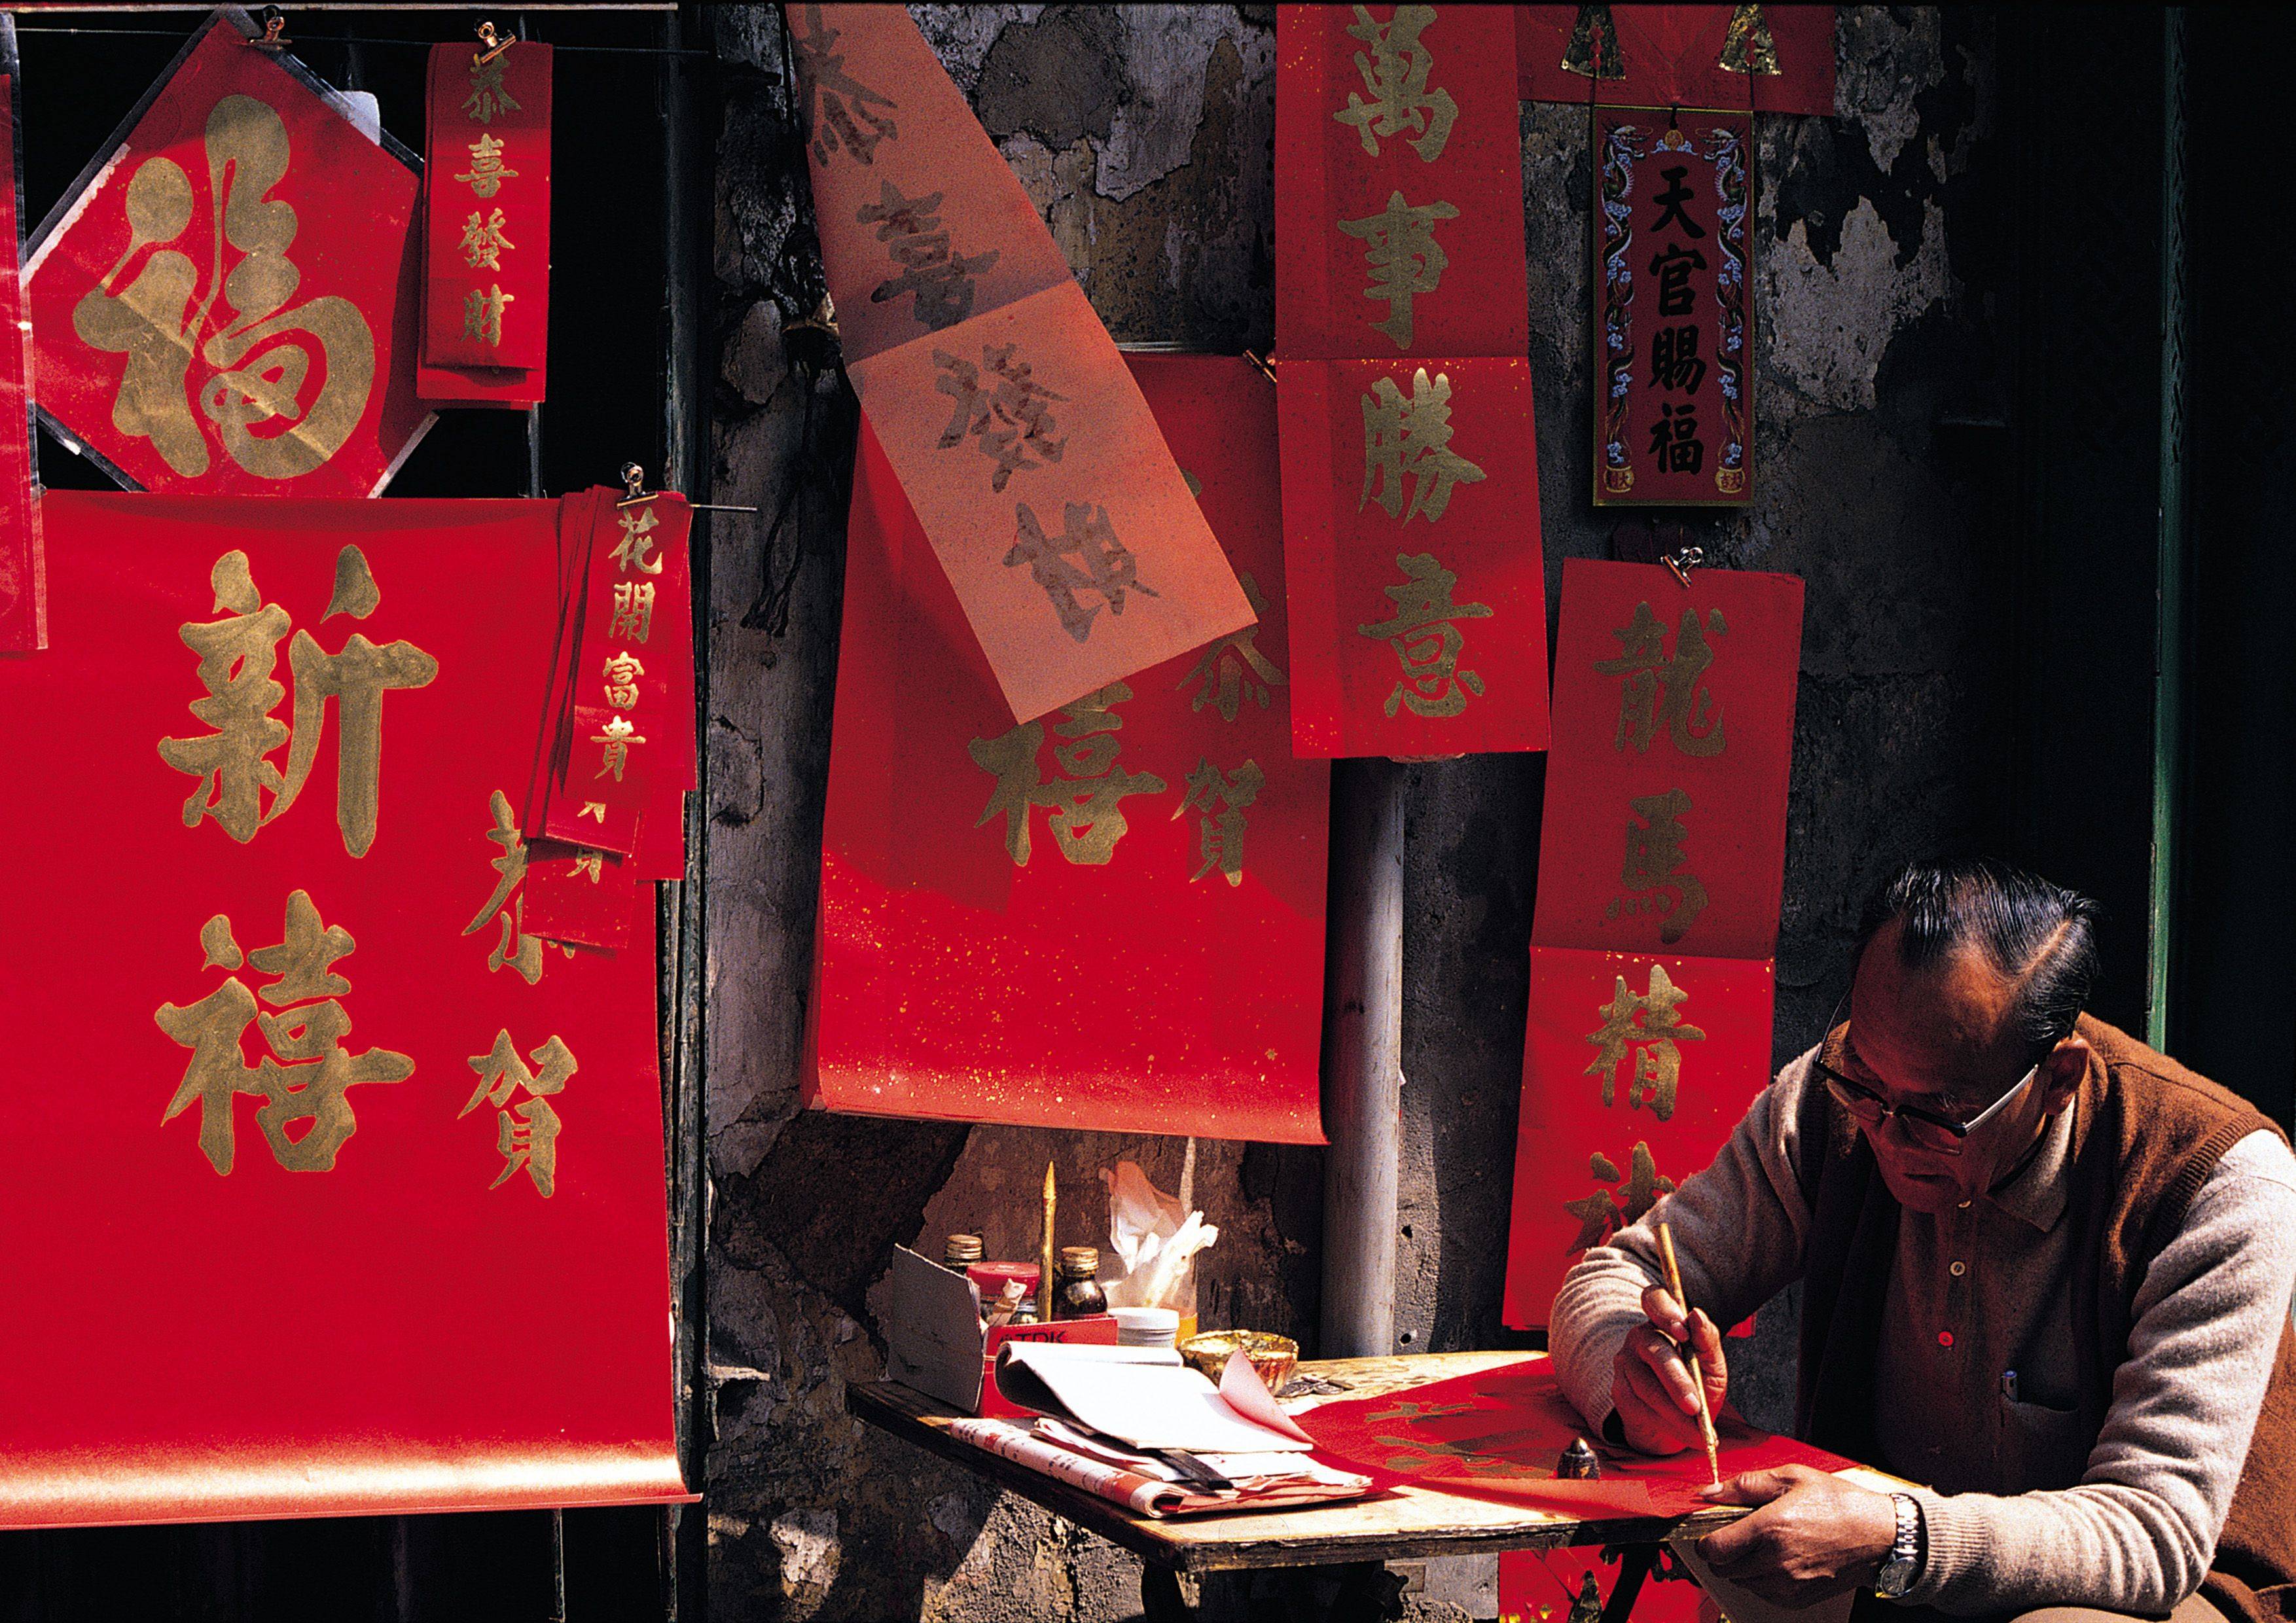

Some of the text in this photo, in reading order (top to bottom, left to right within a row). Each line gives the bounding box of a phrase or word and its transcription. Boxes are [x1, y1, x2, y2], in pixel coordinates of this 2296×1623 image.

[72, 94, 375, 479] 福
[455, 54, 521, 348] 恭喜發財
[1333, 4, 1494, 718] 萬事勝意
[1649, 166, 1704, 475] 天官賜福
[591, 507, 662, 782] 花開富貴
[155, 545, 439, 1175] 新禧
